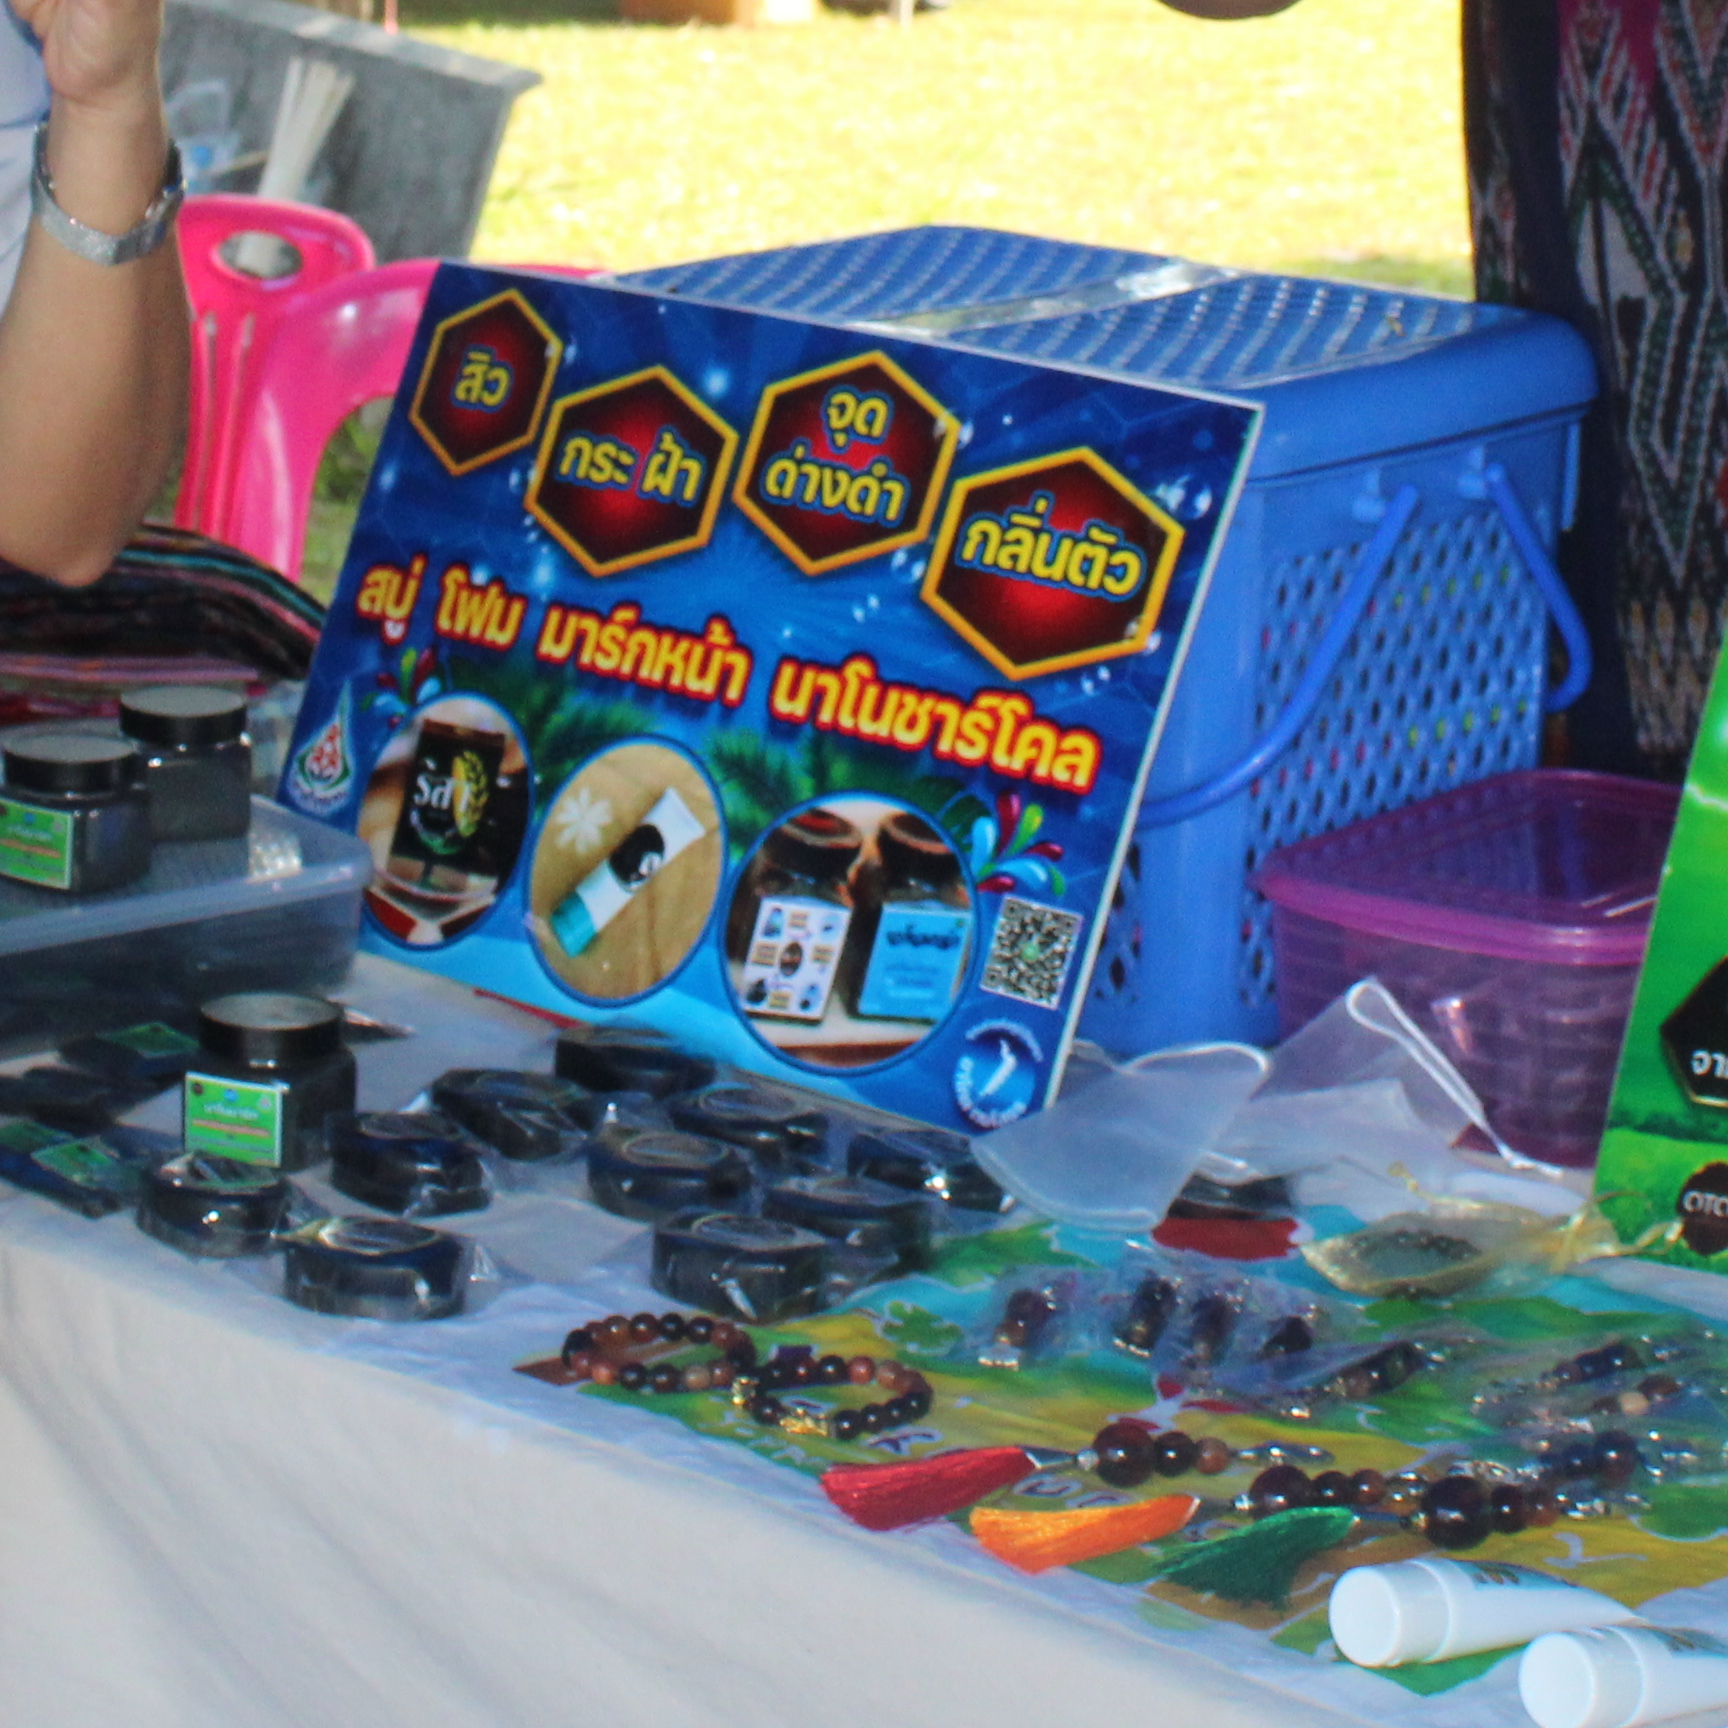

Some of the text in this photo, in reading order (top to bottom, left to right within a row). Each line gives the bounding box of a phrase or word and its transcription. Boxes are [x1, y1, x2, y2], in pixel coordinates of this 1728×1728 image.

[453, 349, 512, 408] สิว
[826, 389, 890, 449] จุด
[559, 430, 704, 502] กระ ฝ้า
[763, 442, 907, 523] ด่างดำ
[960, 496, 1143, 596] กลิ่นตัว
[356, 553, 1101, 794] สบู่ โฟม มาร์กหน้า นาโนชาร์โคล
